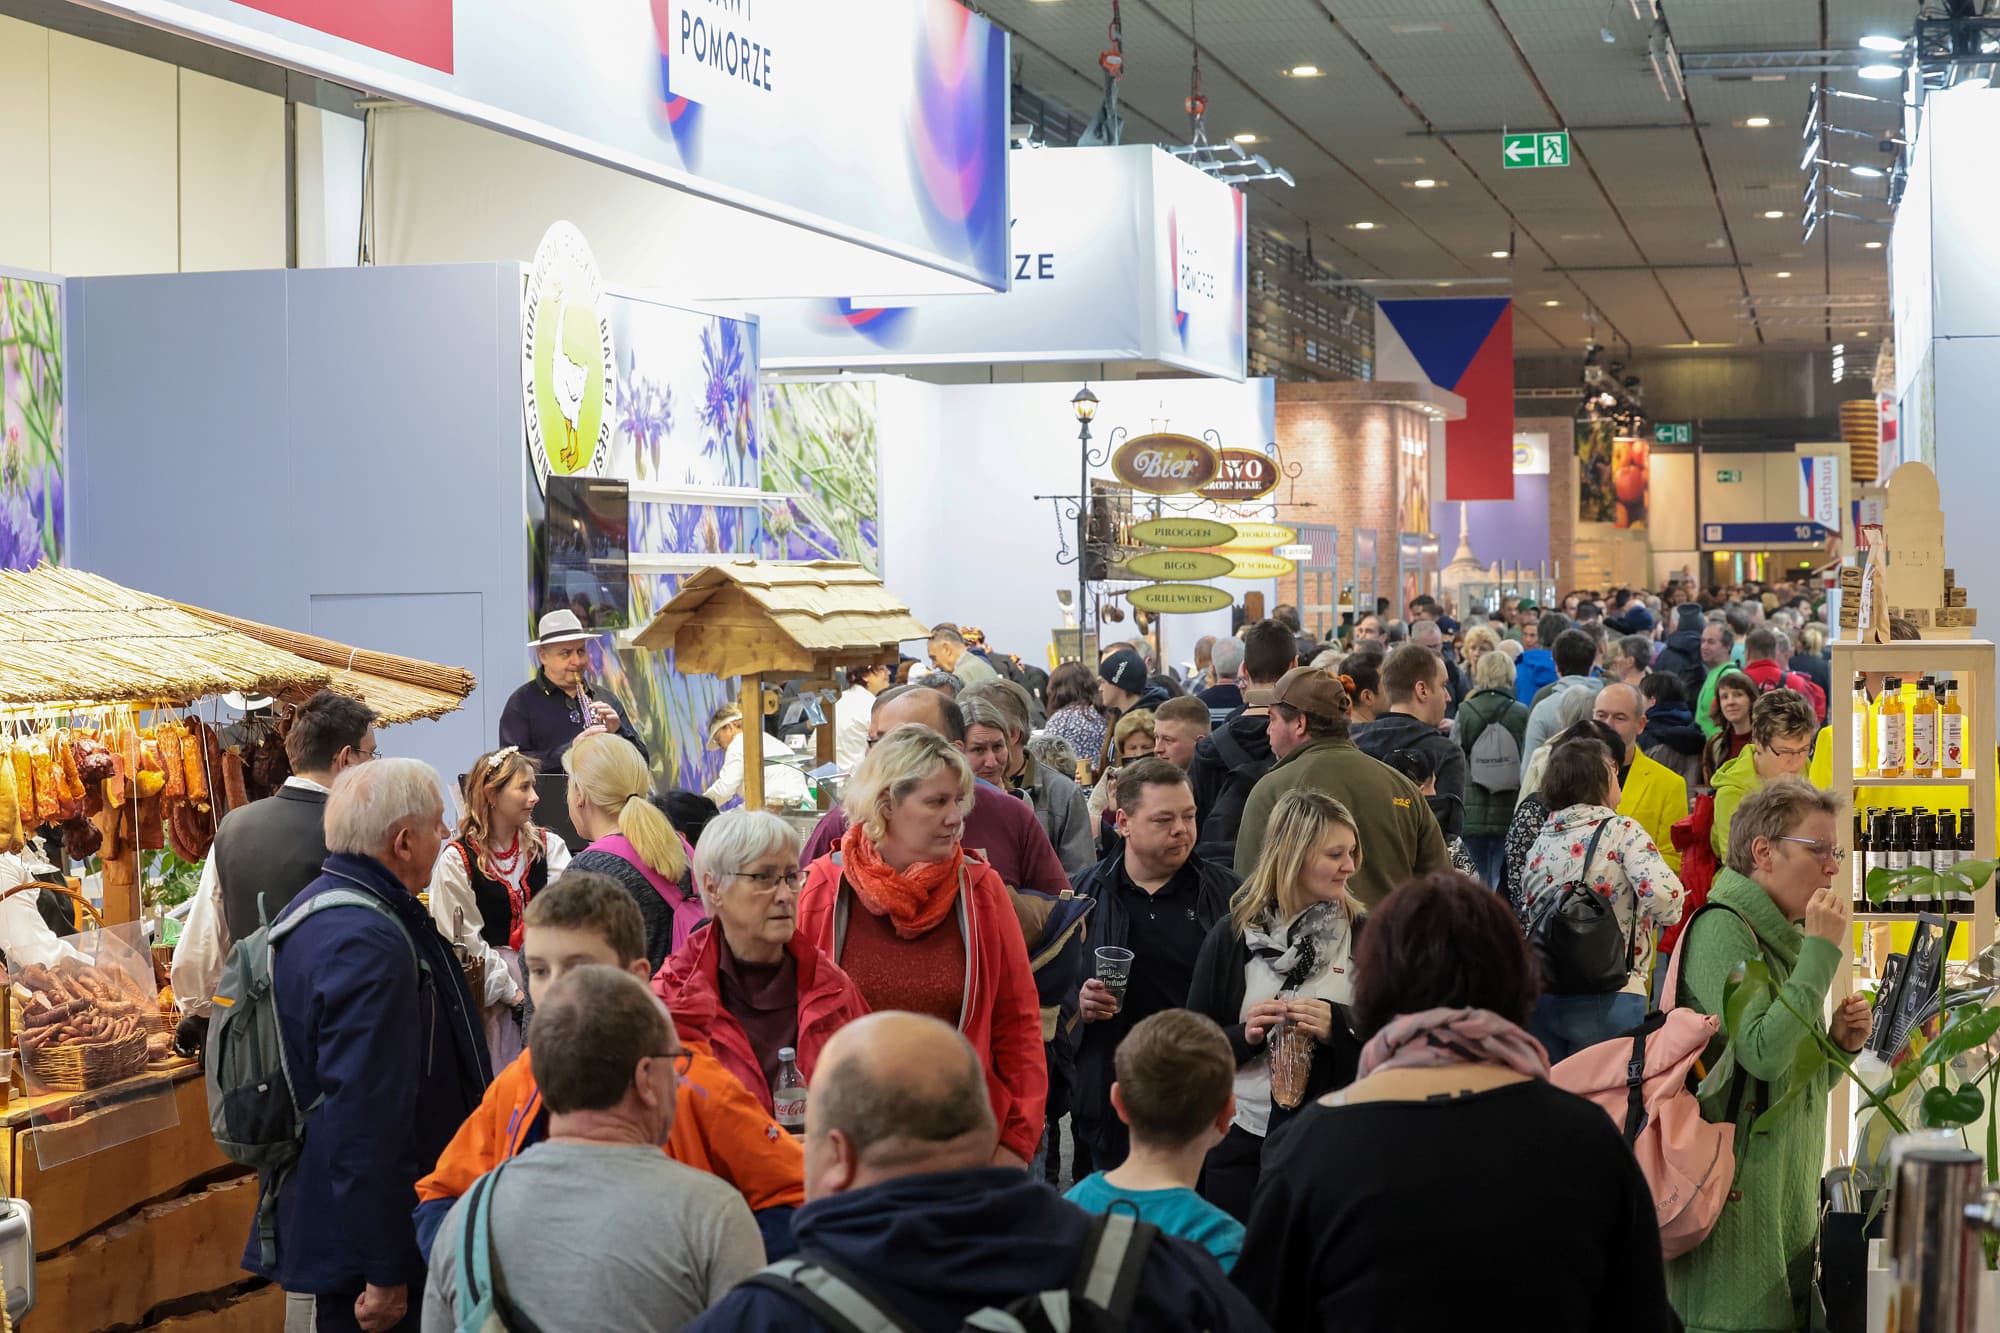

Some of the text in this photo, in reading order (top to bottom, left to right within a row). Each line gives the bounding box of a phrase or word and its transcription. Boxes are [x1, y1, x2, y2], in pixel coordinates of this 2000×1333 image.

[682, 9, 771, 91] POMORZE
[1133, 450, 1199, 478] Bier
[1216, 459, 1263, 478] IWO
[1819, 459, 1833, 522] Gasthaus
[1154, 527, 1212, 537] PIROGGEN
[1794, 526, 1811, 540] 10
[1164, 560, 1197, 571] BIGOS
[1146, 594, 1215, 604] GRILLWURST
